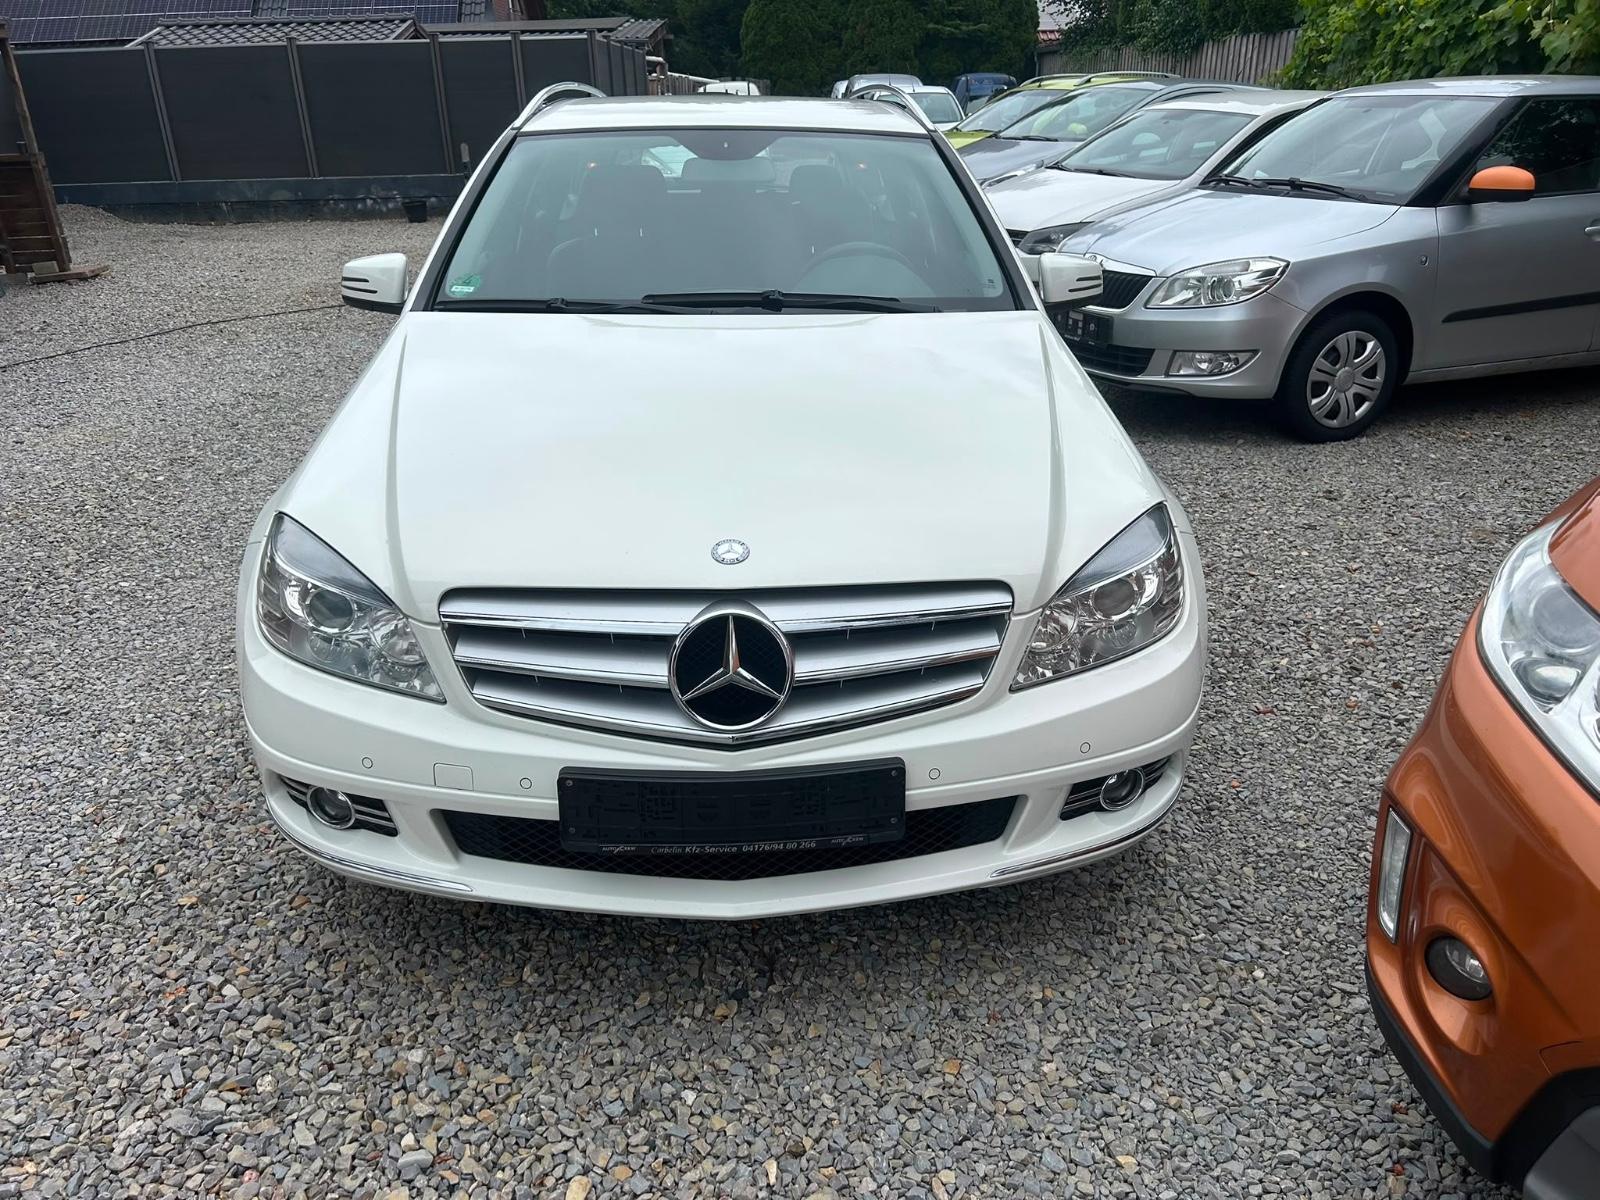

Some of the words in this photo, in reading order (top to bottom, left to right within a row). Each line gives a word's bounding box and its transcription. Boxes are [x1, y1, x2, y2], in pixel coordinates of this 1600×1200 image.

[685, 845, 738, 854] Kfz-Service
[742, 841, 784, 852] 04176/94
[786, 842, 798, 850] 80
[800, 841, 816, 850] 266
